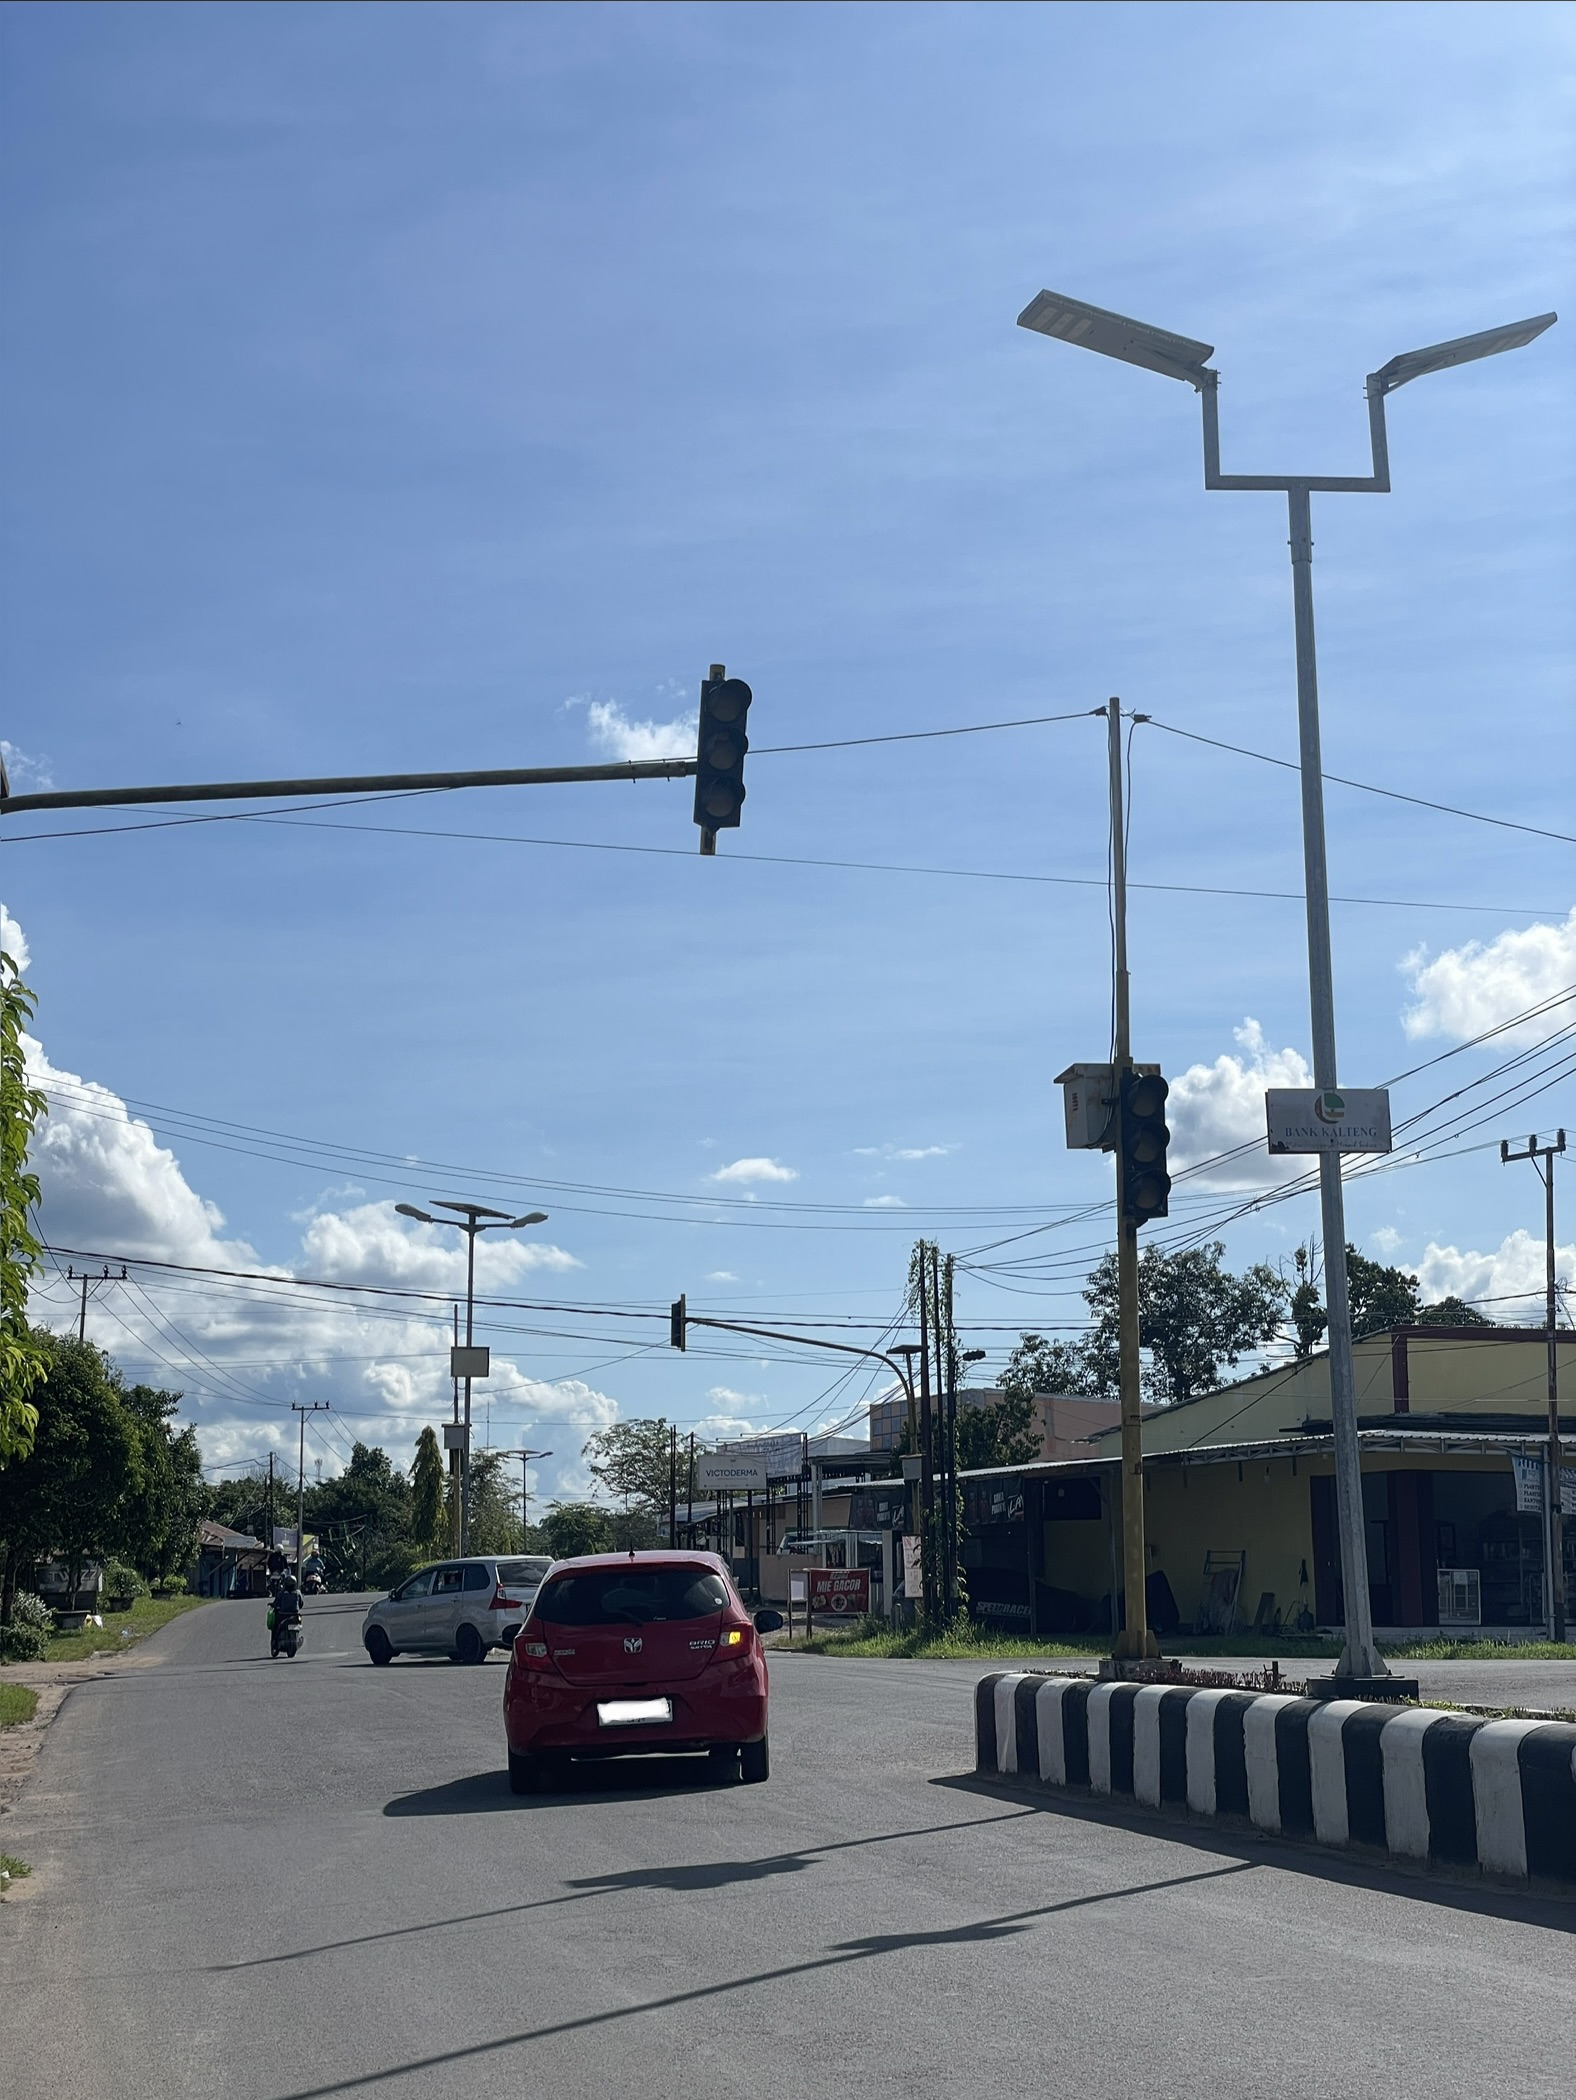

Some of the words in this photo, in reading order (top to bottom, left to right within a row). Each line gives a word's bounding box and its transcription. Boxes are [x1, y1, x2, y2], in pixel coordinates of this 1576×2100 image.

[1285, 1127, 1317, 1137] BANK
[1322, 1127, 1377, 1137] KALTENG
[705, 1469, 758, 1477] VICTODERMA
[817, 1580, 832, 1593] MIE
[833, 1579, 861, 1592] GACOR
